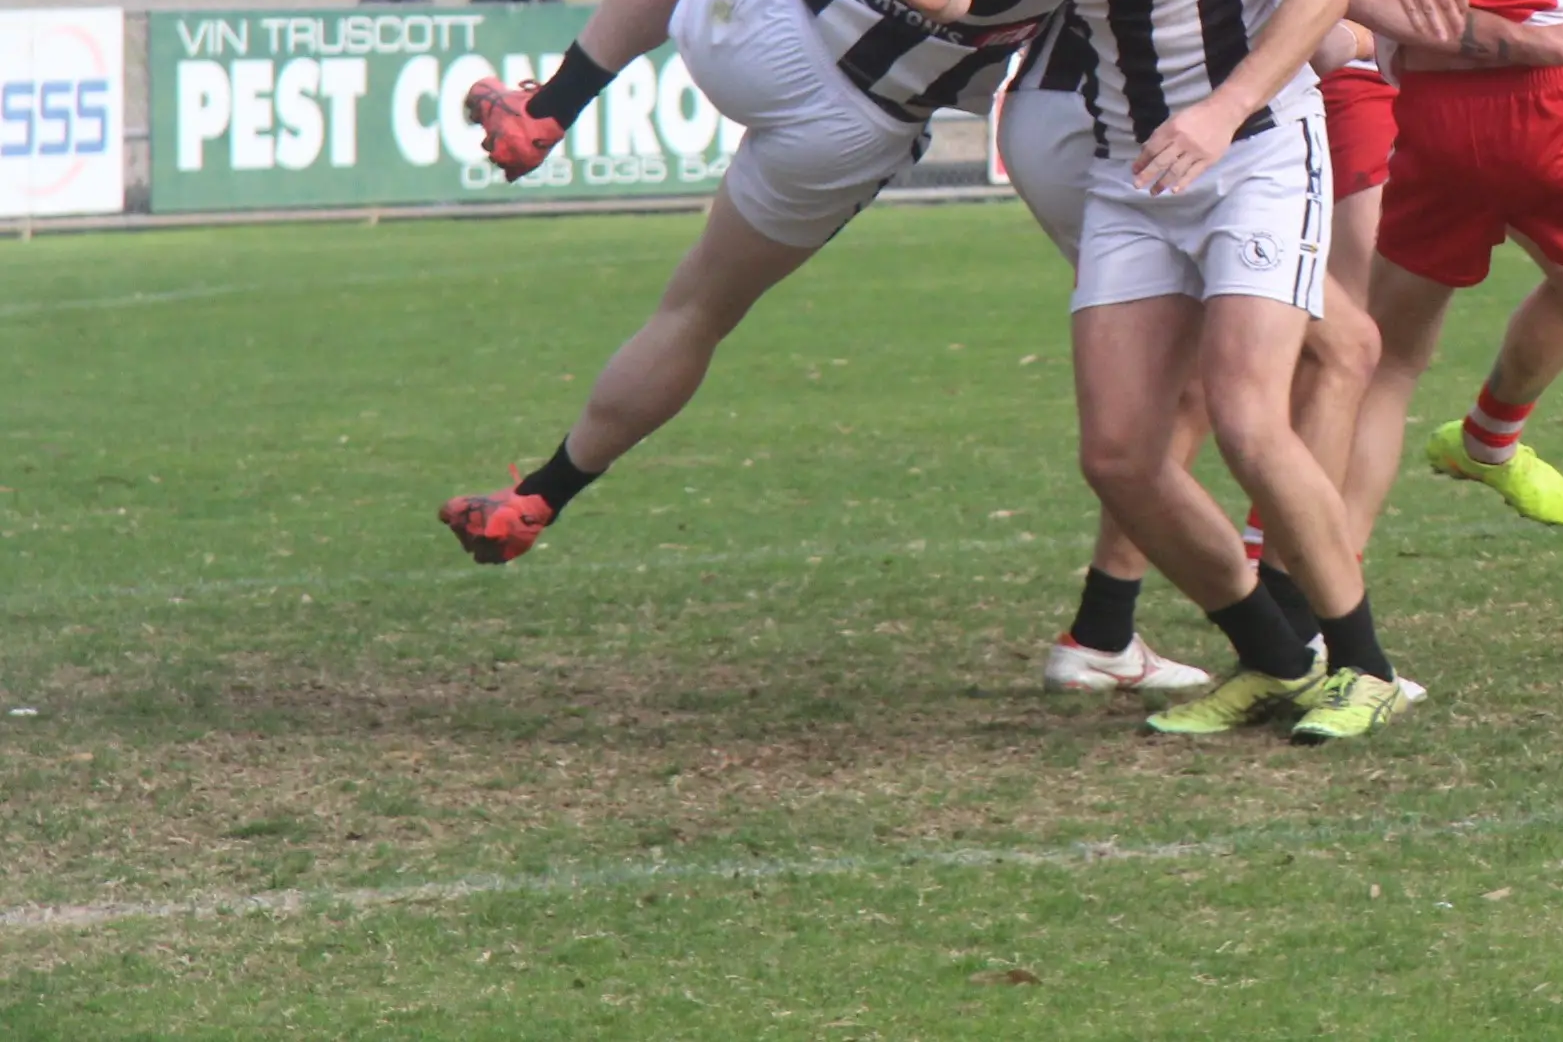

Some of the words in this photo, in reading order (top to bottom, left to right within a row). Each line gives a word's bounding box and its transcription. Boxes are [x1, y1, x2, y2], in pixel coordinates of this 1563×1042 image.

[176, 18, 248, 56] VIN
[260, 14, 485, 54] TRUSCOTT
[177, 56, 367, 171] PEST
